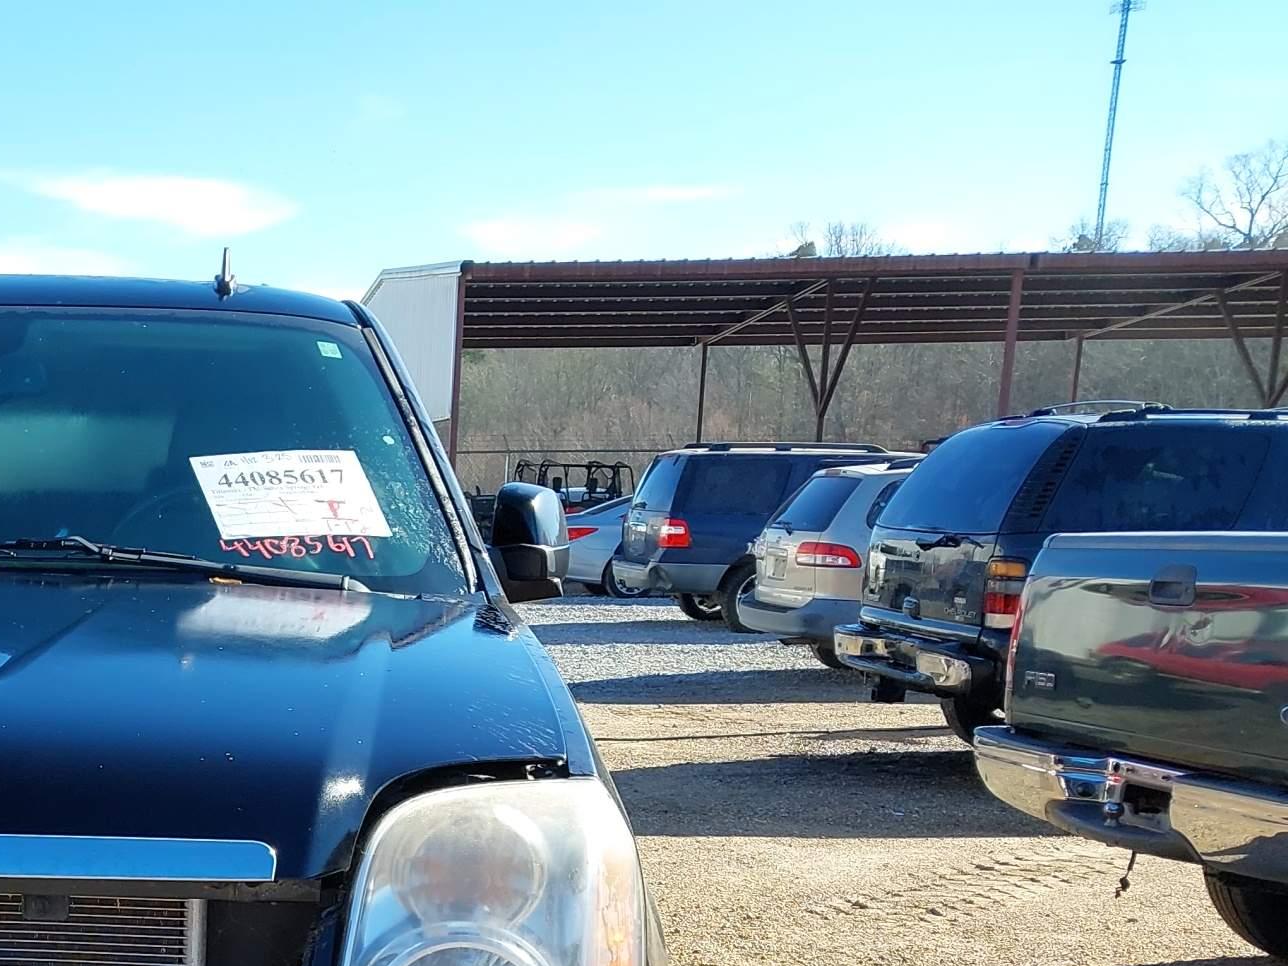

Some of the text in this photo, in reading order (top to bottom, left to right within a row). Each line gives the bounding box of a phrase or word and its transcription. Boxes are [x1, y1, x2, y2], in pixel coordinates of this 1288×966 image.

[218, 469, 343, 488] 44085617
[219, 534, 375, 560] 44085617
[944, 607, 976, 619] CHEVROLET
